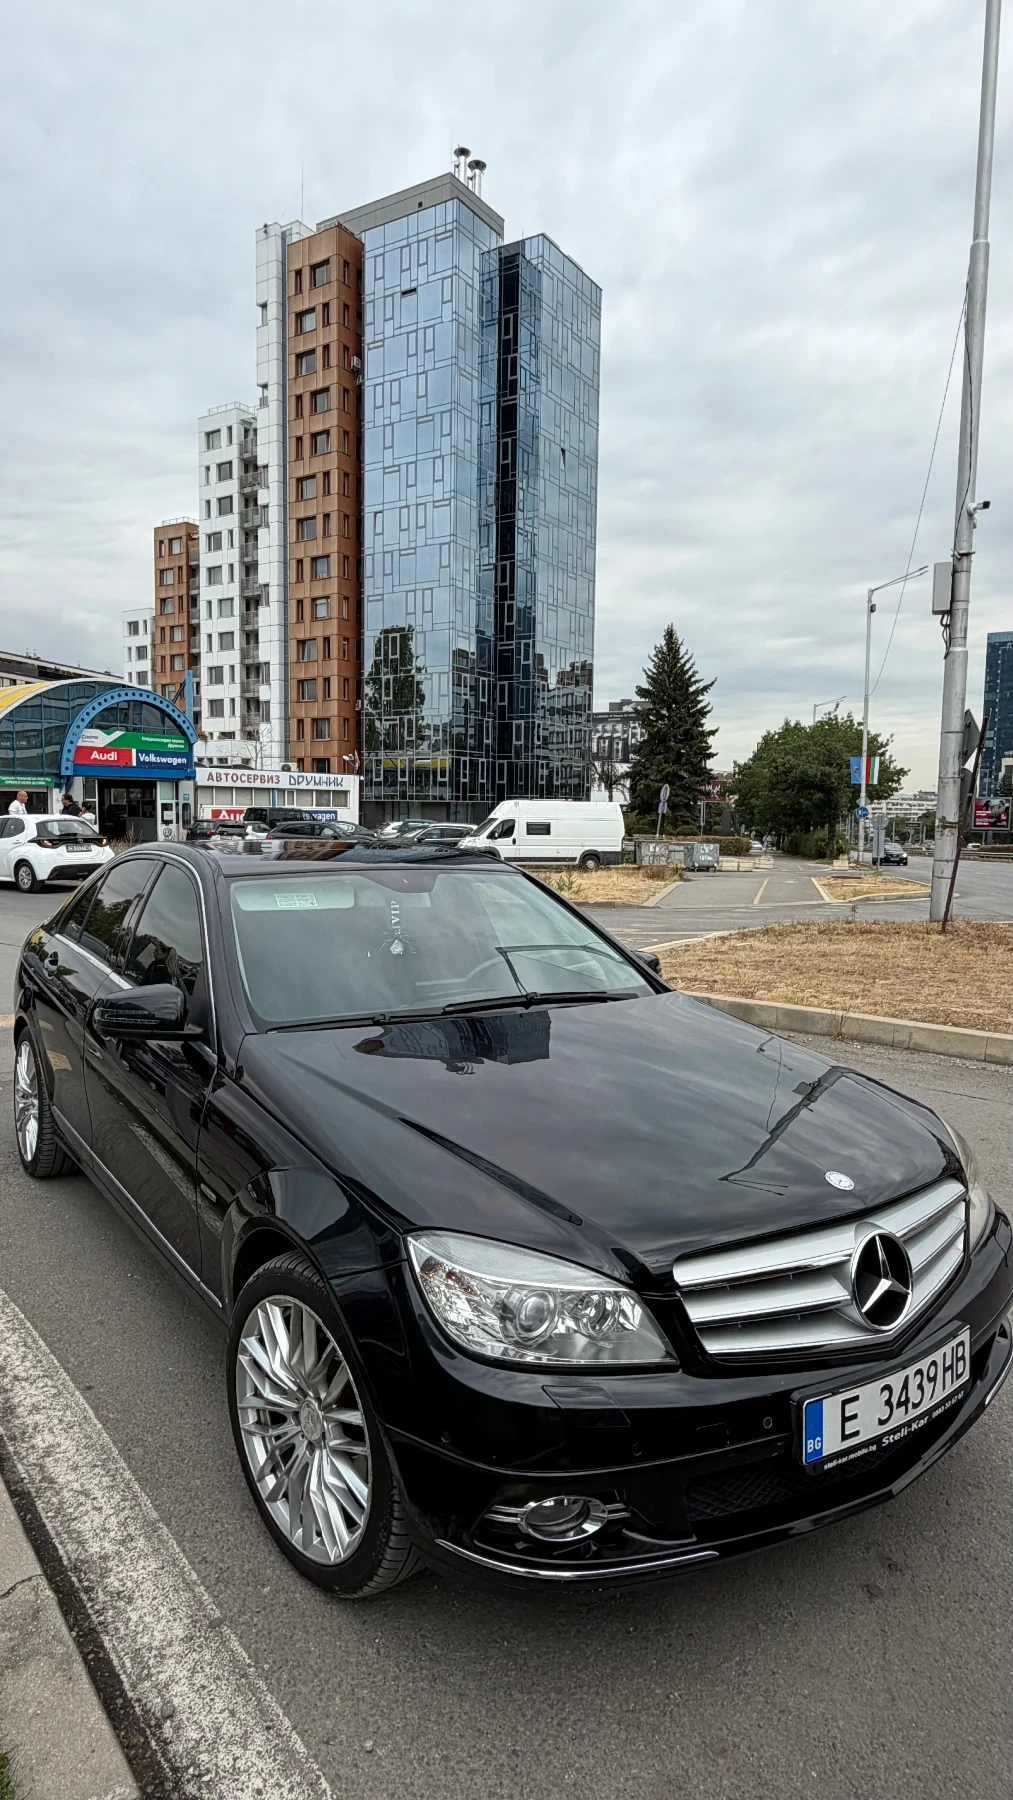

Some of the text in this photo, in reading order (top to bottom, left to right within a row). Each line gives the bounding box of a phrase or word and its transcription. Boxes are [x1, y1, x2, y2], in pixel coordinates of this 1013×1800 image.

[90, 750, 118, 761] Audi
[138, 752, 187, 766] Volkswagen
[206, 771, 281, 784] АВТОСЕРВИЗ
[840, 1394, 860, 1443] E
[882, 1415, 929, 1447] Steli-Kar
[806, 1436, 822, 1454] BG
